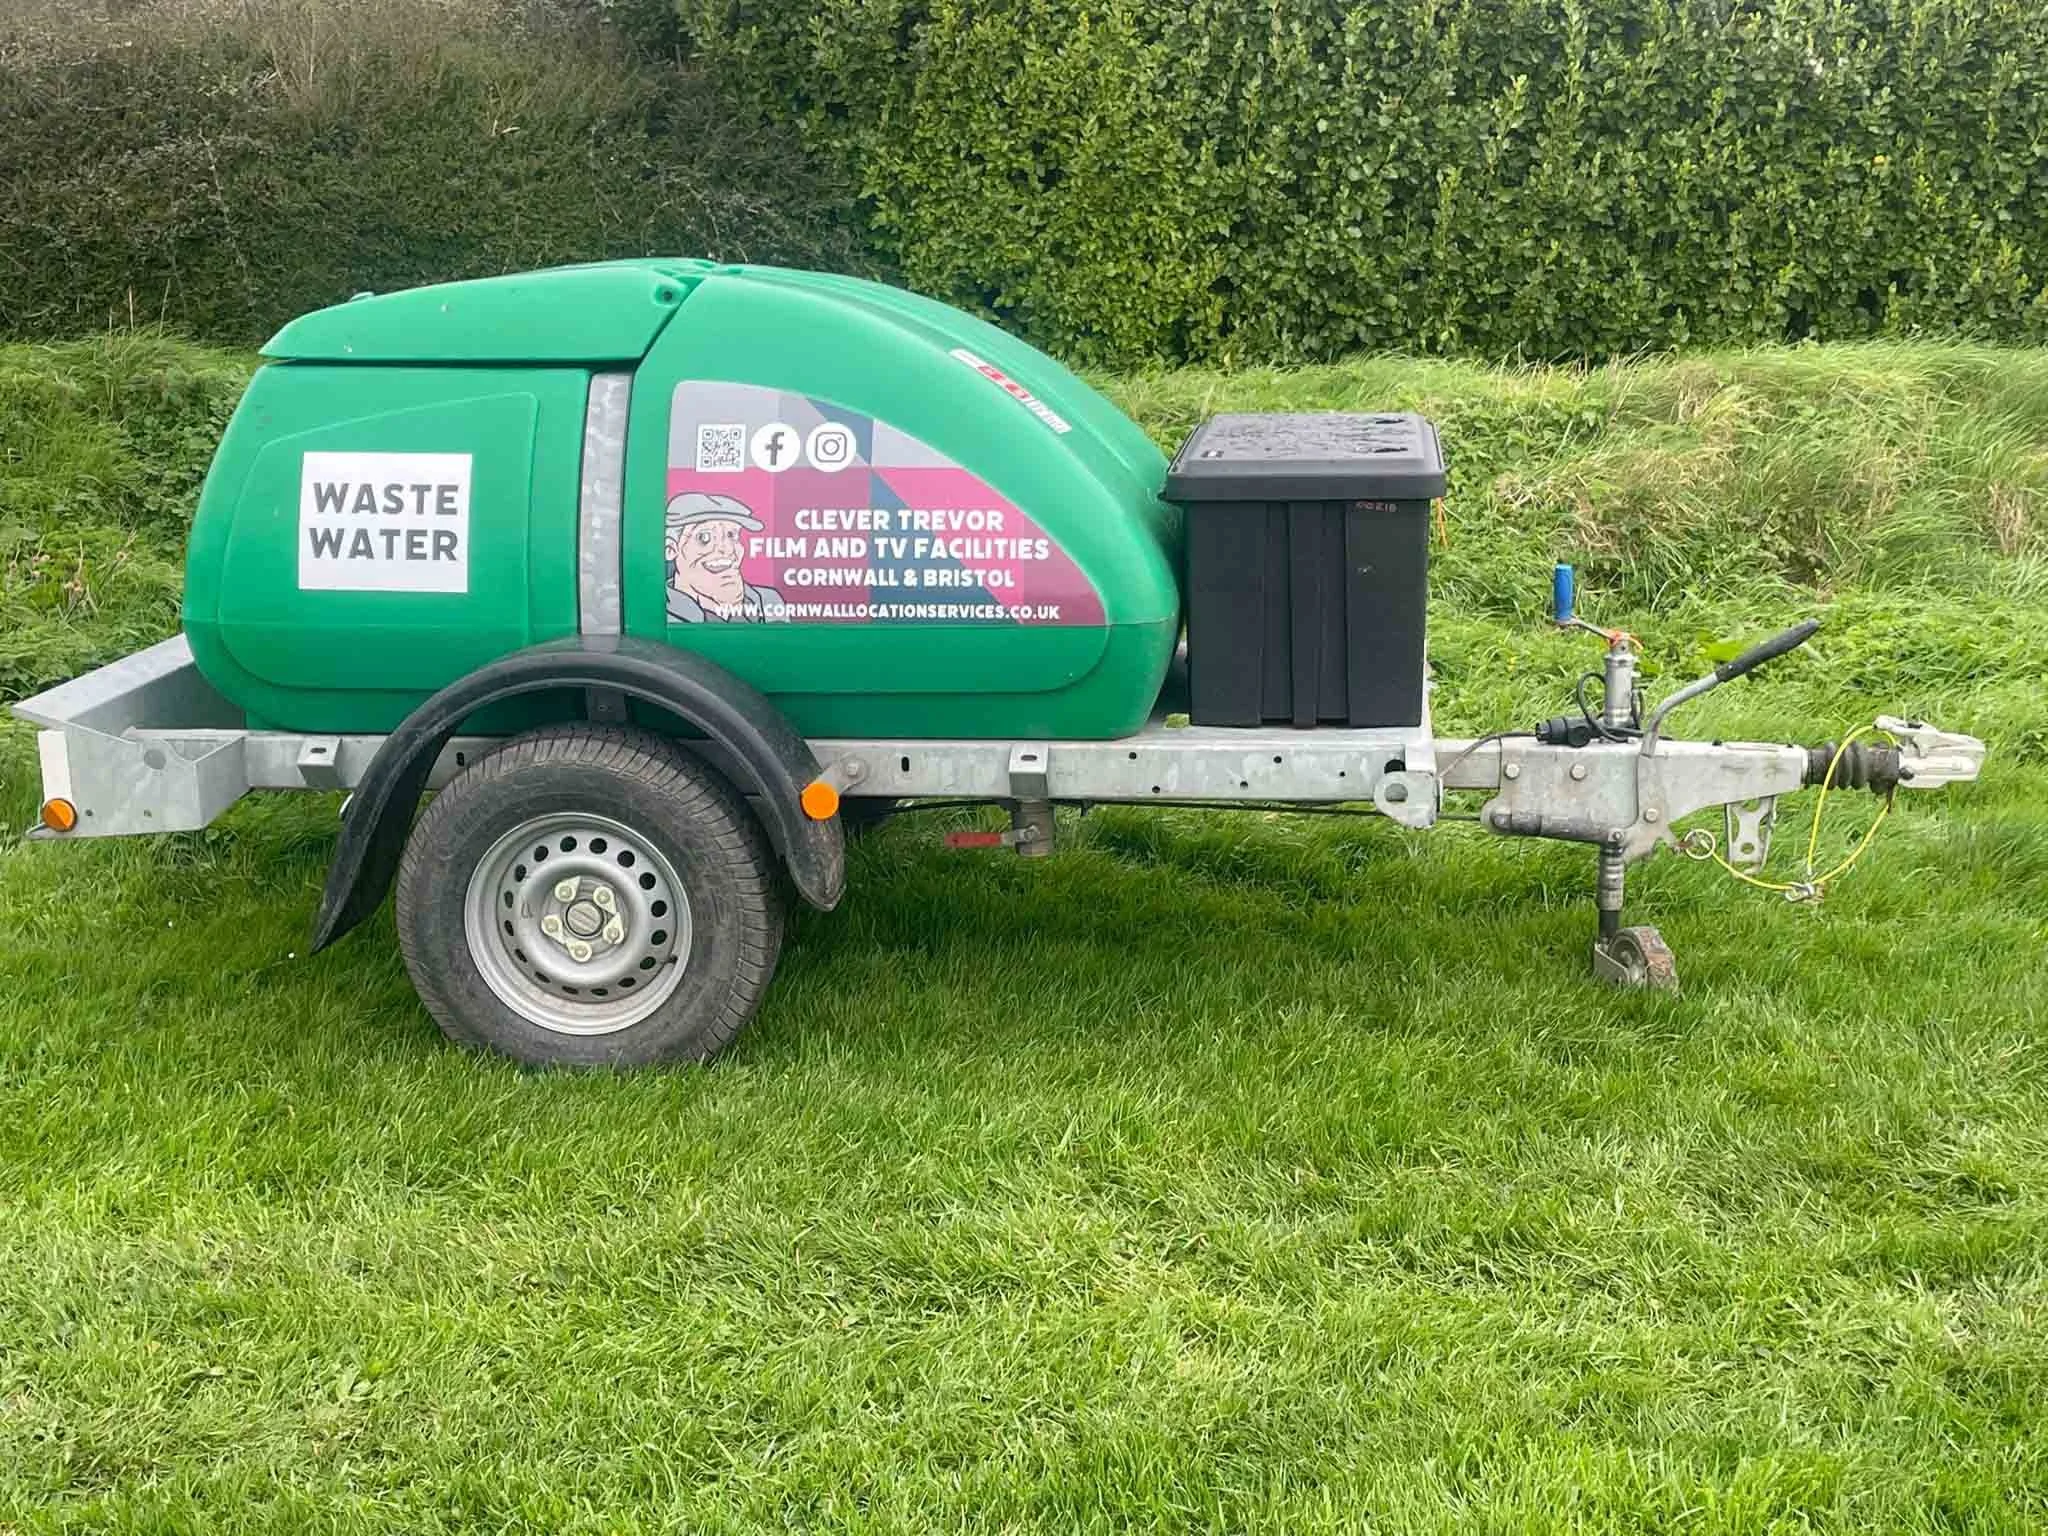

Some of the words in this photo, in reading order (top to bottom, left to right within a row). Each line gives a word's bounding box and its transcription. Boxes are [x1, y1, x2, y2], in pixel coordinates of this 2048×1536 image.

[312, 482, 460, 516] WASTE
[794, 509, 890, 531] CLEVER
[897, 509, 1005, 532] TREVOR
[309, 527, 459, 562] WATER
[749, 537, 807, 559] FILM
[813, 537, 867, 559] AND
[874, 538, 907, 559] TV
[914, 538, 1050, 561] FACILITIES
[783, 568, 899, 587] CORNWALL
[903, 568, 918, 586] &
[923, 569, 1016, 588] BRISTOL
[714, 602, 1060, 620] WWW.CORNWALLLOCATIONSERVICES.CO.UK
